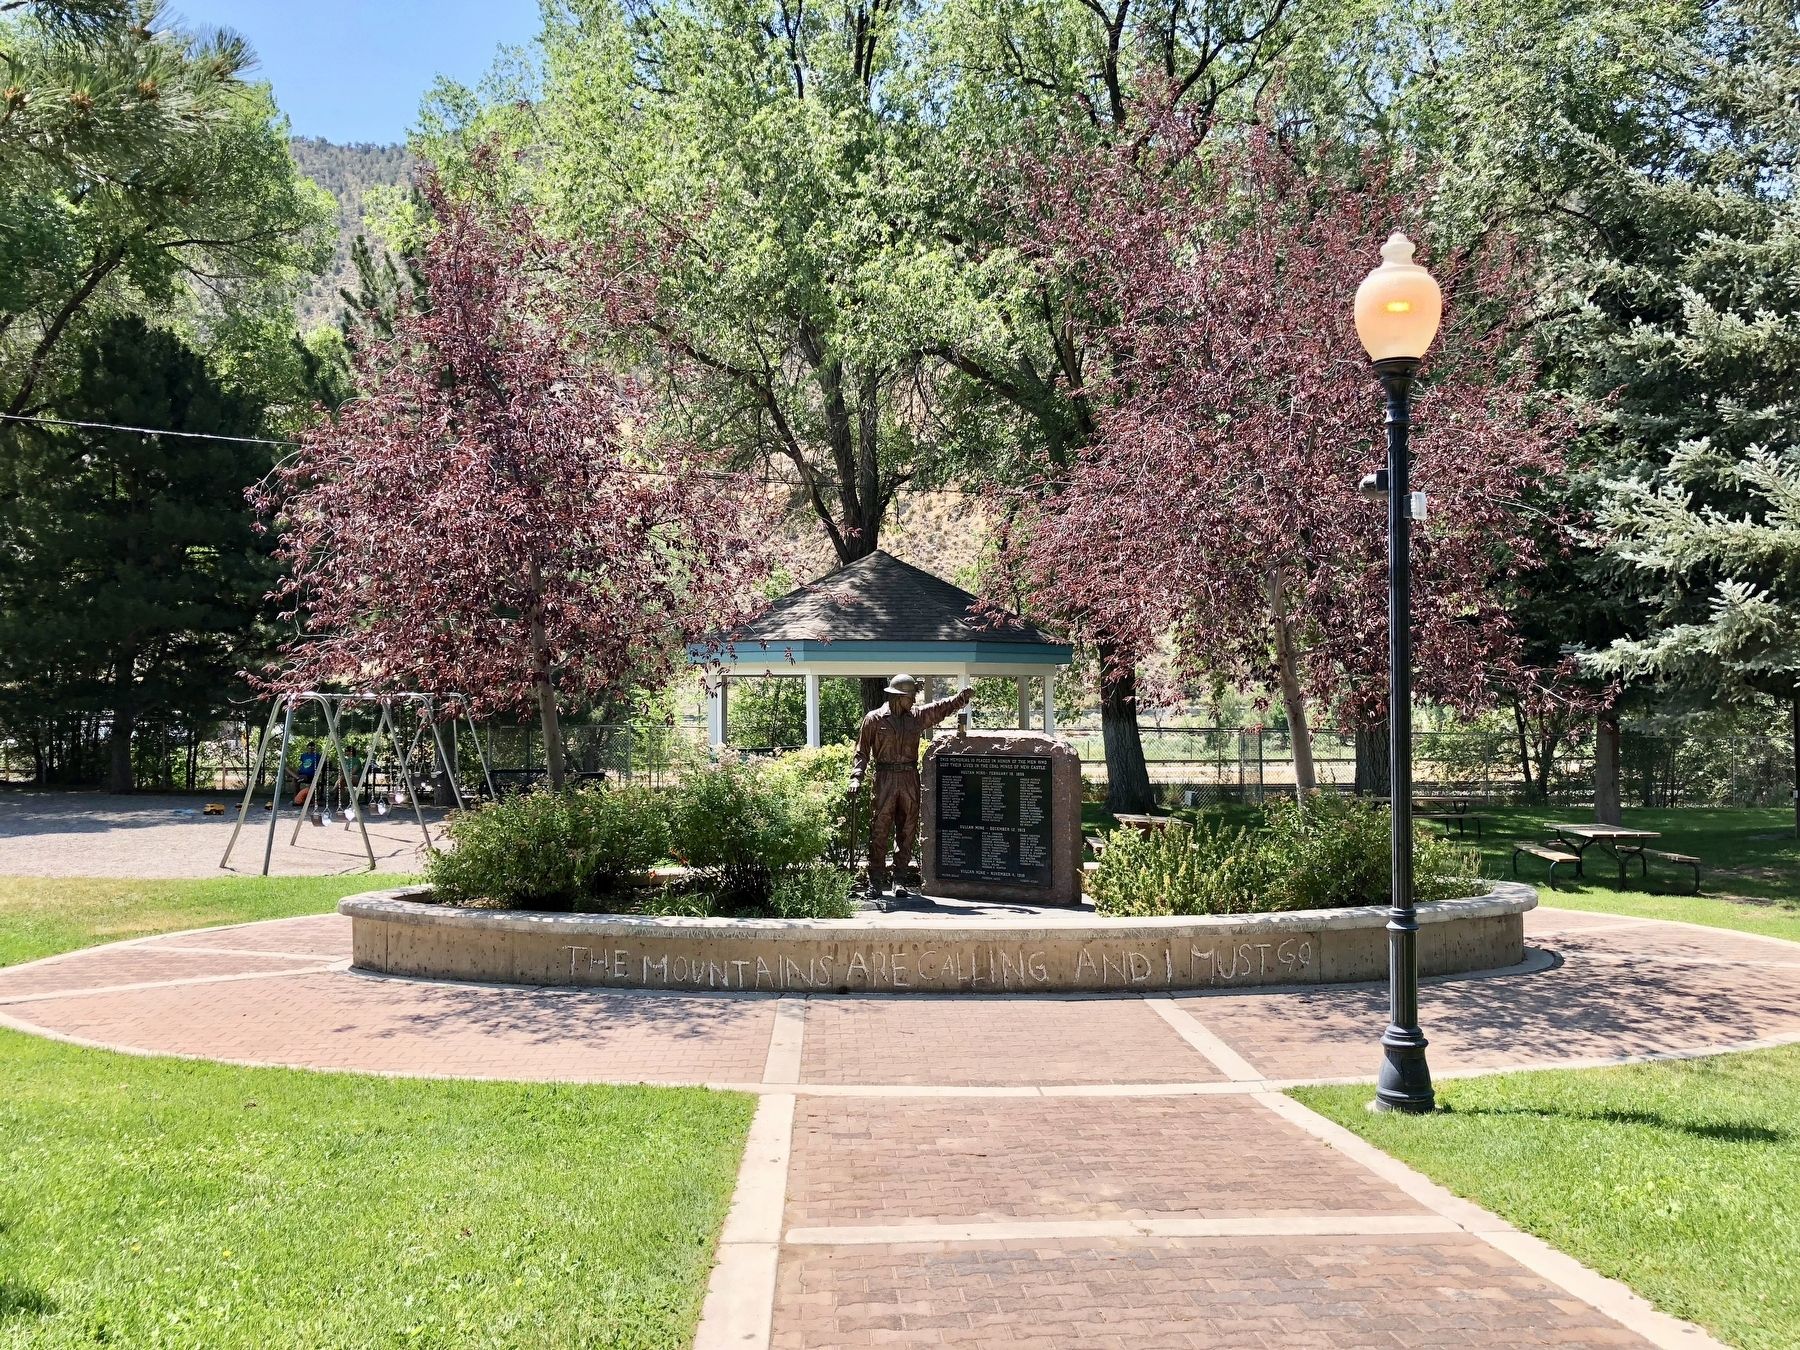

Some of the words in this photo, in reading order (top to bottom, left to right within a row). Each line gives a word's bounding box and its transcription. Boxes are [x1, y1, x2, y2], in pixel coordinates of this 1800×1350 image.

[562, 945, 630, 978] THE
[642, 954, 834, 989] MOUNTAINS
[846, 952, 911, 987] ARE
[918, 950, 1048, 988] CALLING
[1073, 948, 1152, 985] AND
[1165, 948, 1173, 983] I
[1190, 943, 1271, 984] MUST
[1277, 938, 1312, 973] GO
